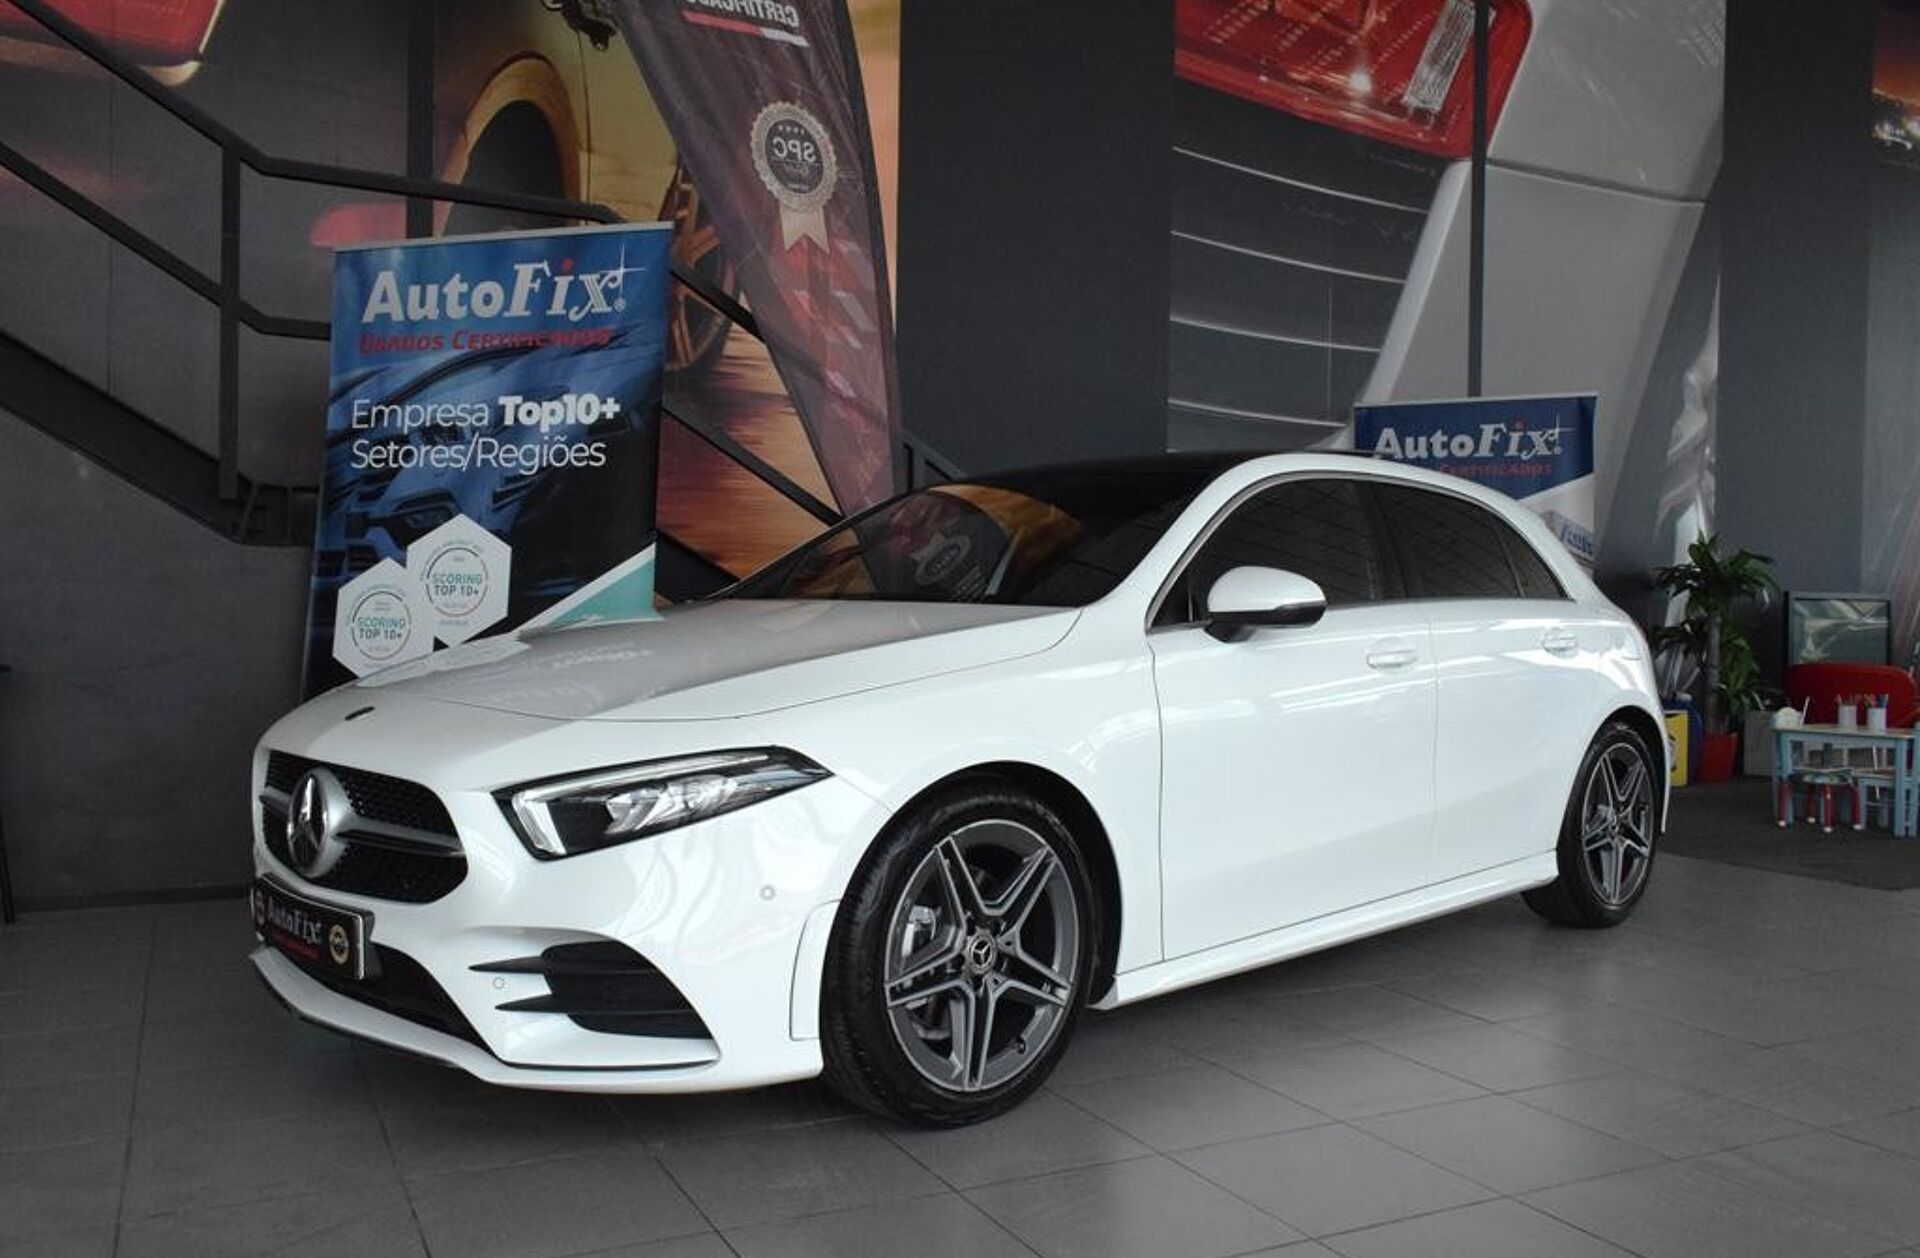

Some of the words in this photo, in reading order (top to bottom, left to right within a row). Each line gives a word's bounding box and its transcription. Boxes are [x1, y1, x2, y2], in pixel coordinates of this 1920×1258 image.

[352, 399, 490, 431] Empresa
[498, 394, 621, 433] Top10+
[351, 432, 607, 474] Setores/Regiões
[432, 573, 482, 585] SCORING
[434, 585, 457, 596] TOP
[359, 628, 381, 639] TOP
